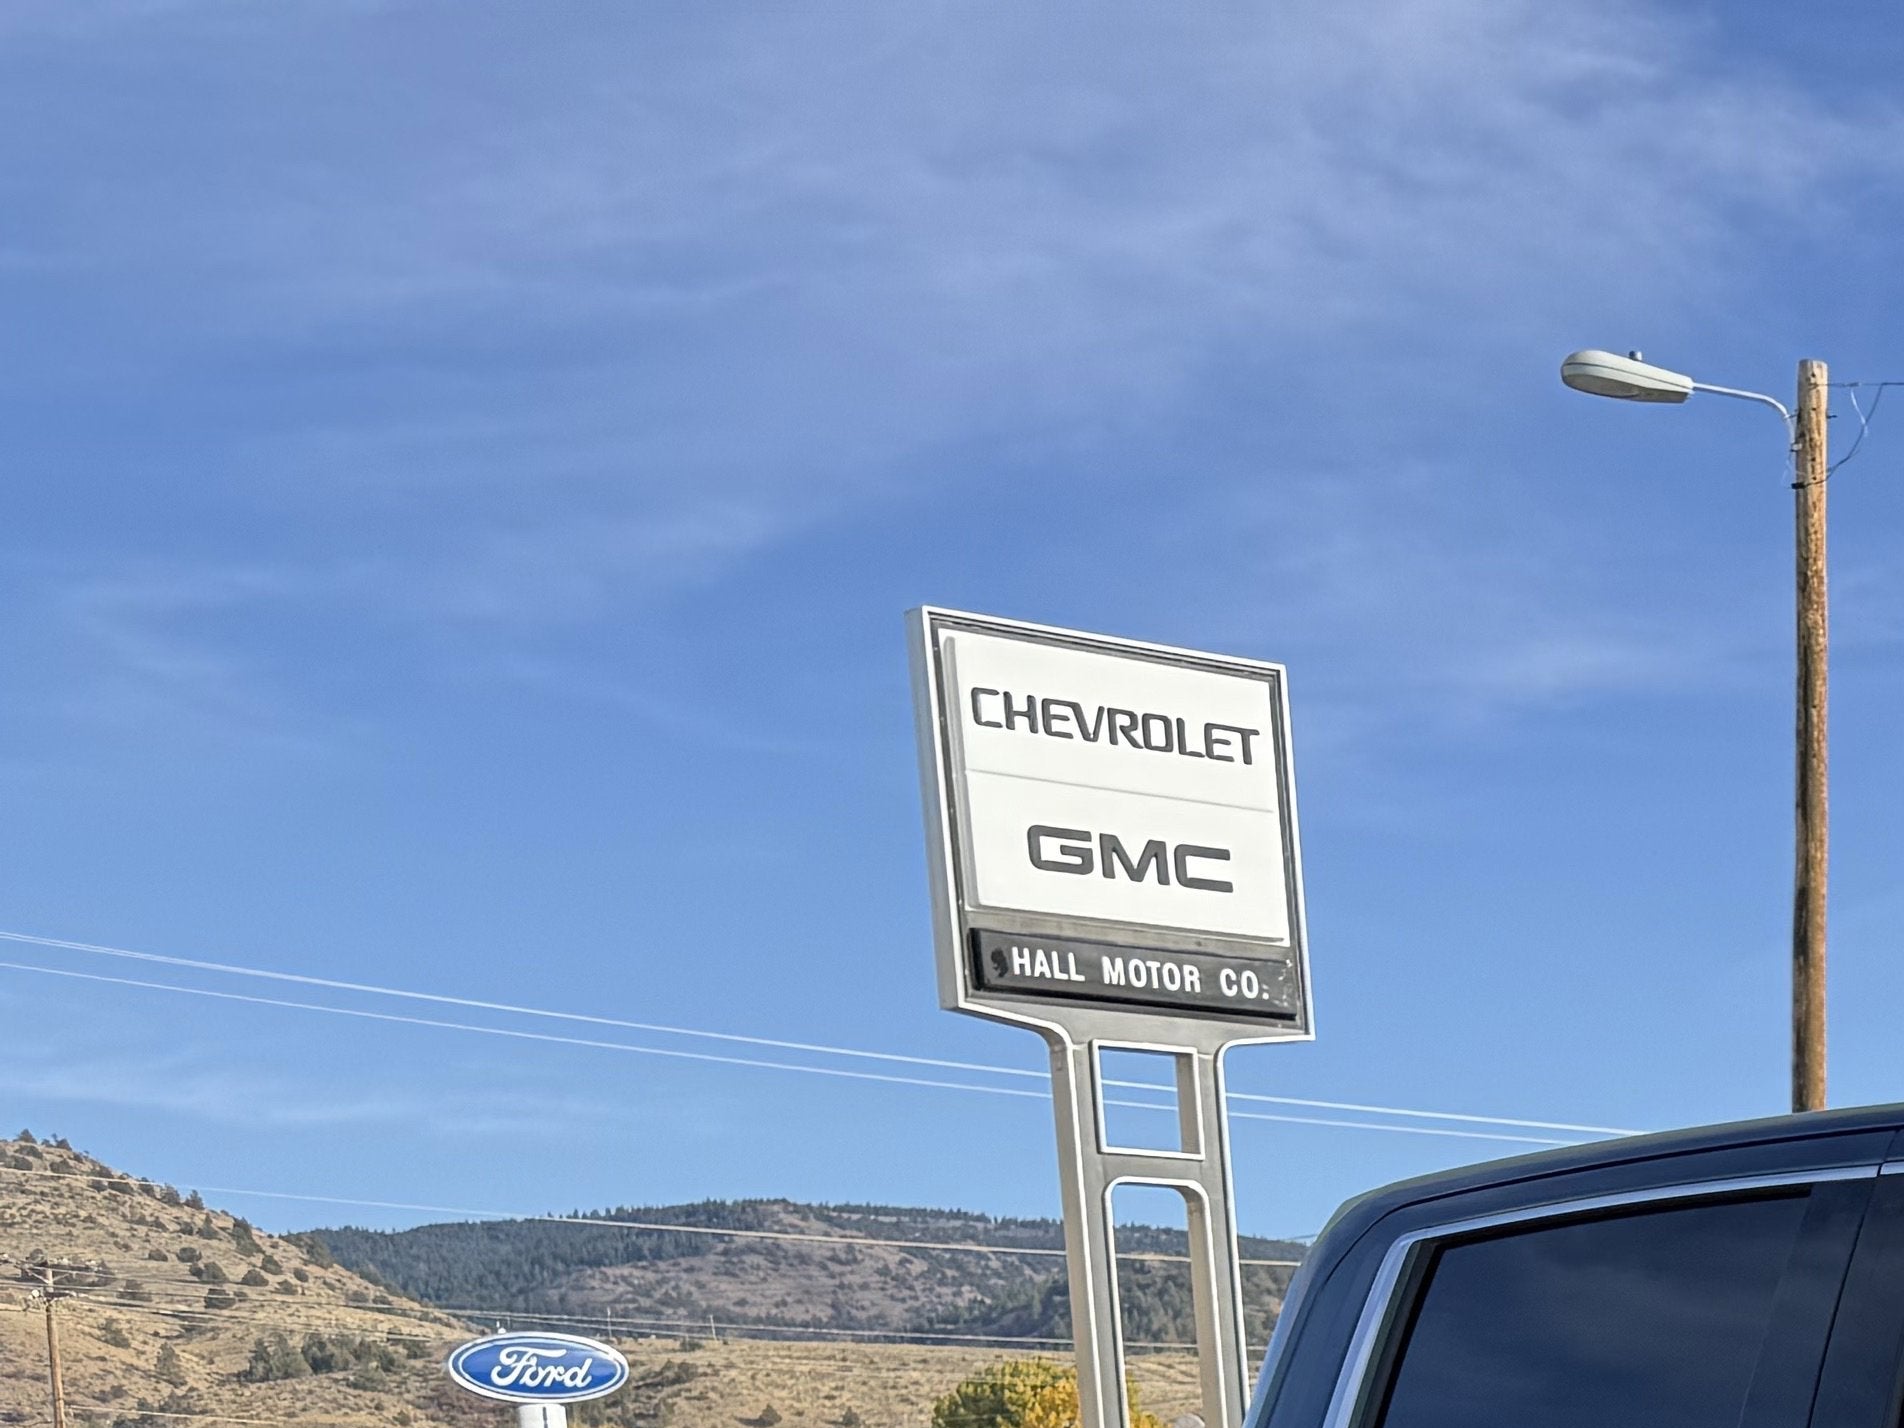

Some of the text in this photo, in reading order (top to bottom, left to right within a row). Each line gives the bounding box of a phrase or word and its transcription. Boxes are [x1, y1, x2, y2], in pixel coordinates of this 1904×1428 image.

[971, 687, 1260, 765] CHEVROLET
[1027, 824, 1234, 893] GMC
[1012, 946, 1085, 982] HALL
[1102, 956, 1201, 993] MOTOR
[490, 1346, 593, 1388] Ford
